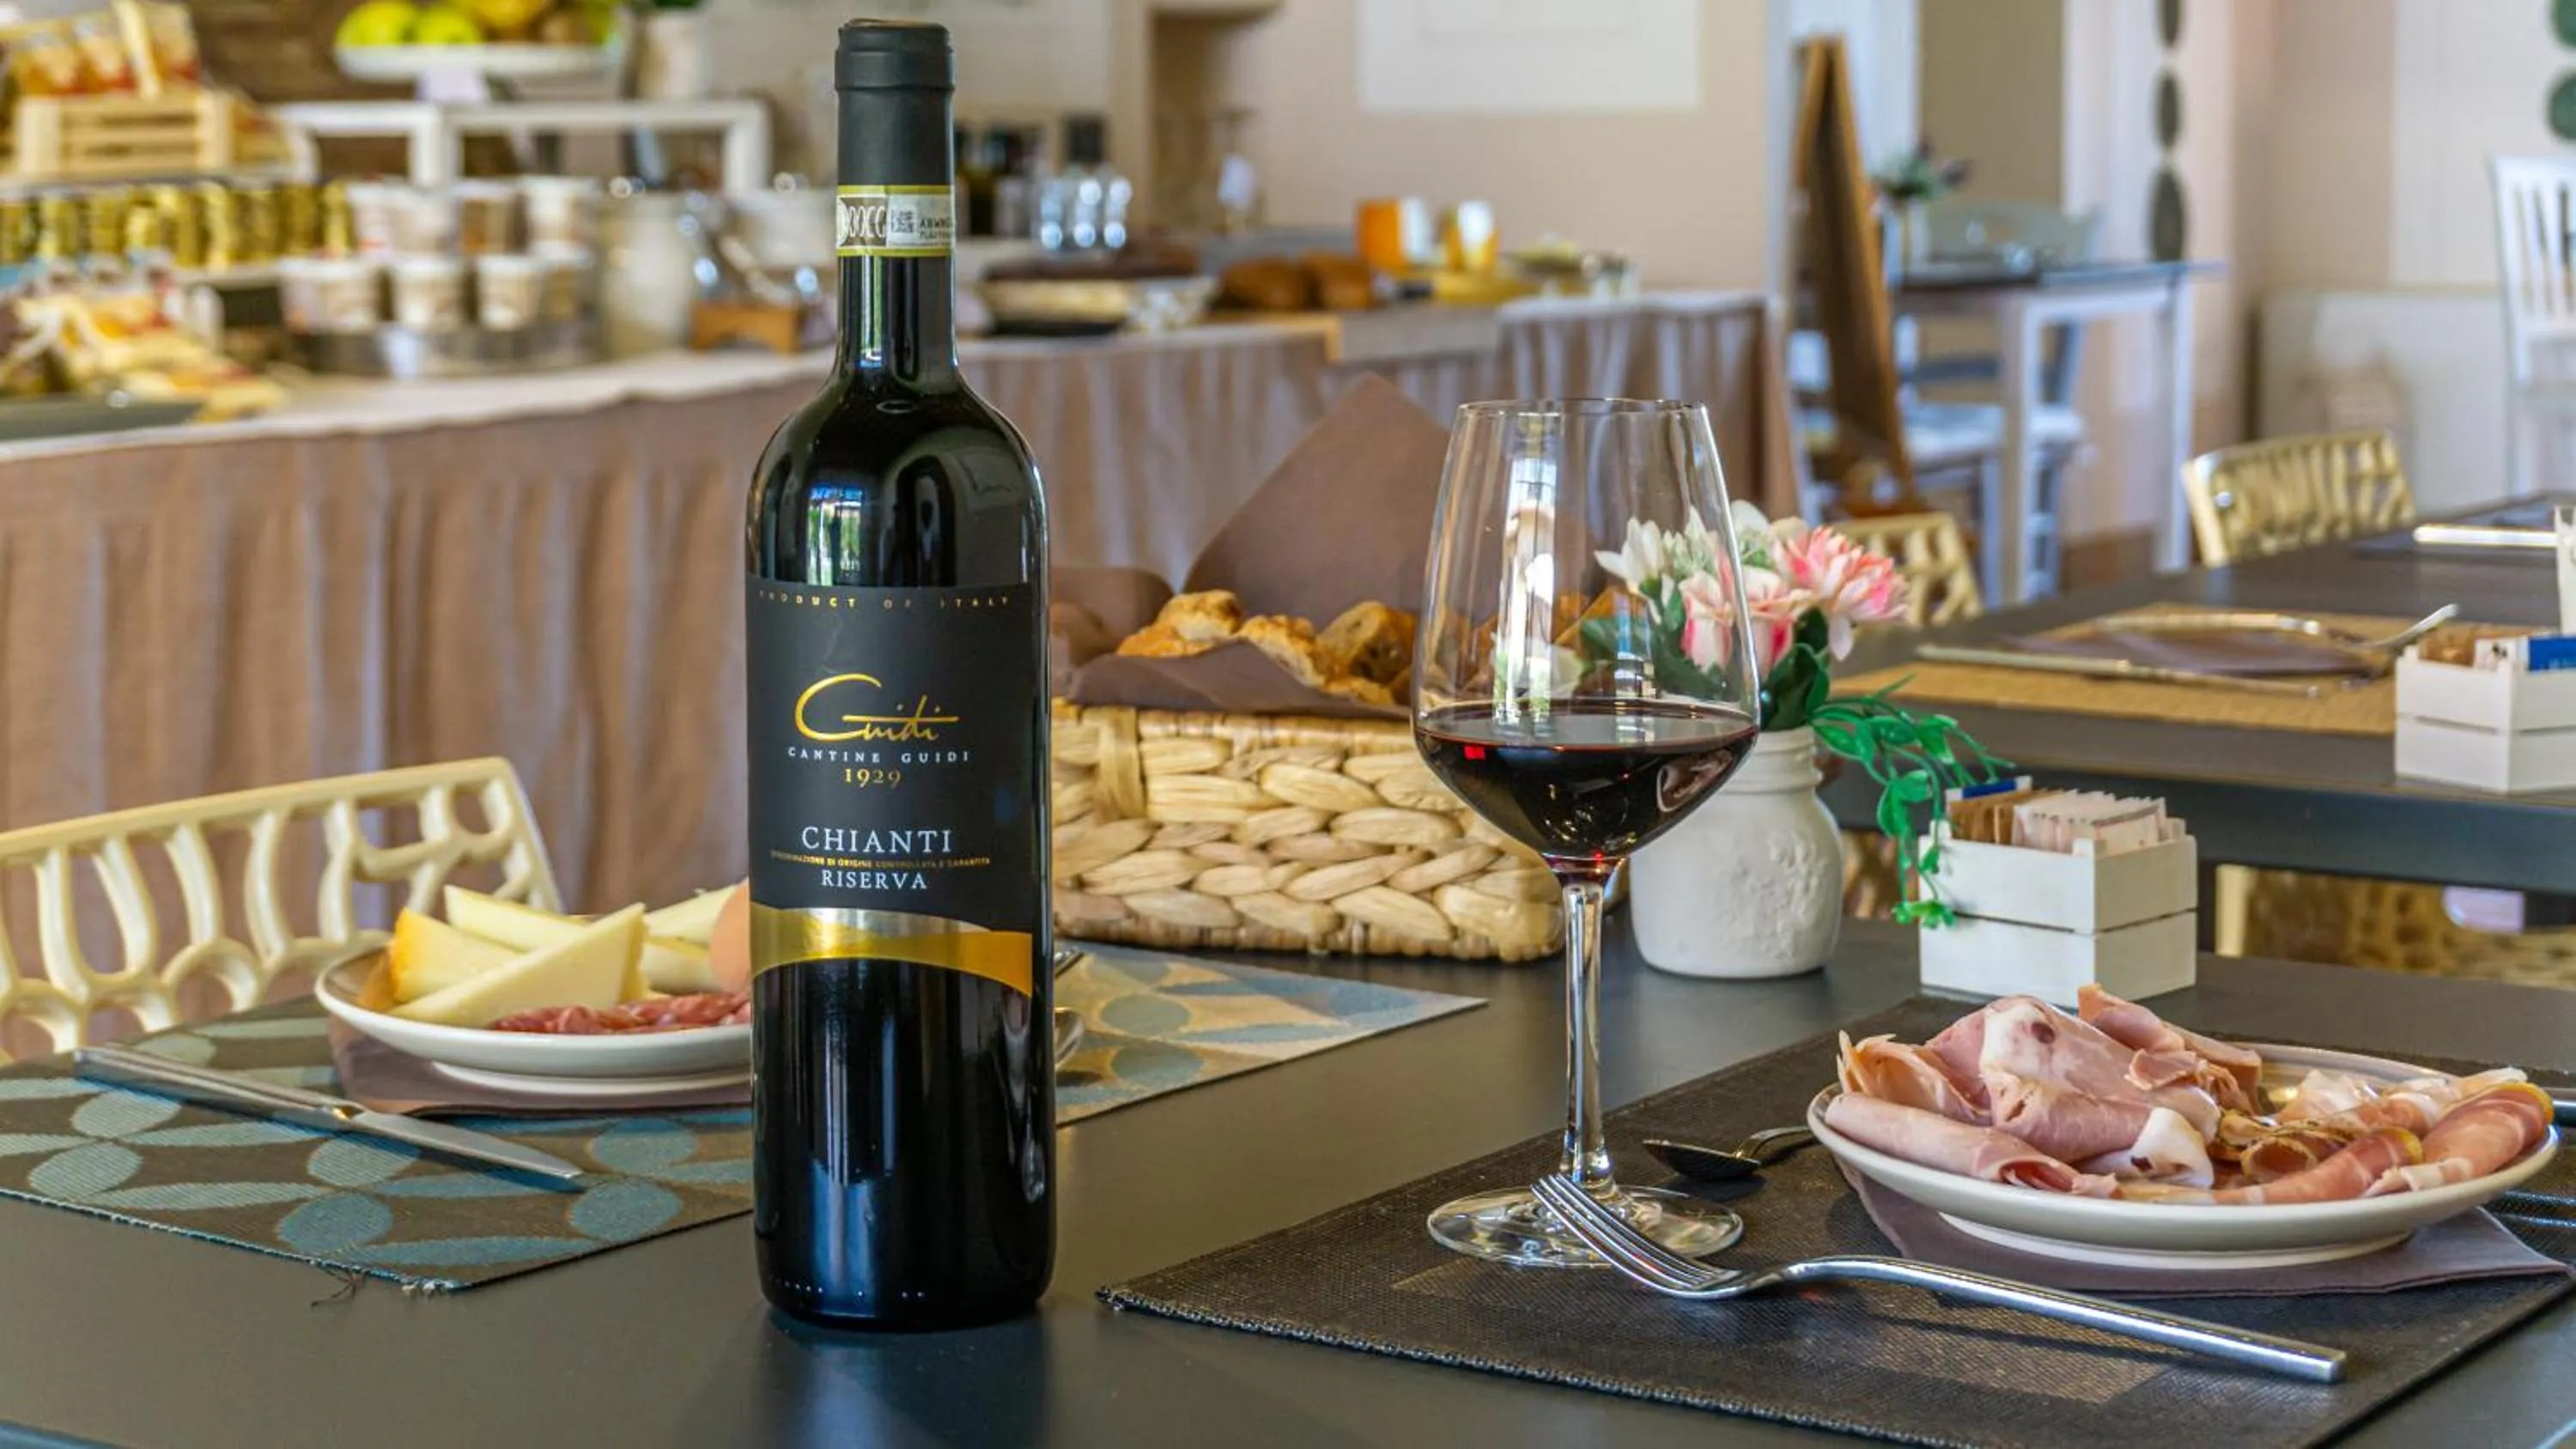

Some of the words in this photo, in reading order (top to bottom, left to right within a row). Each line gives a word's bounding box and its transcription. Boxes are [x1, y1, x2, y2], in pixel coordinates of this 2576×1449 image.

[759, 590, 855, 608] PRODUCT
[883, 598, 911, 610] OF
[787, 746, 880, 763] CANTINE
[901, 751, 969, 763] GUIDI
[844, 768, 902, 788] 1929
[801, 827, 951, 853] CHIANTI
[822, 869, 927, 890] RISERVA
